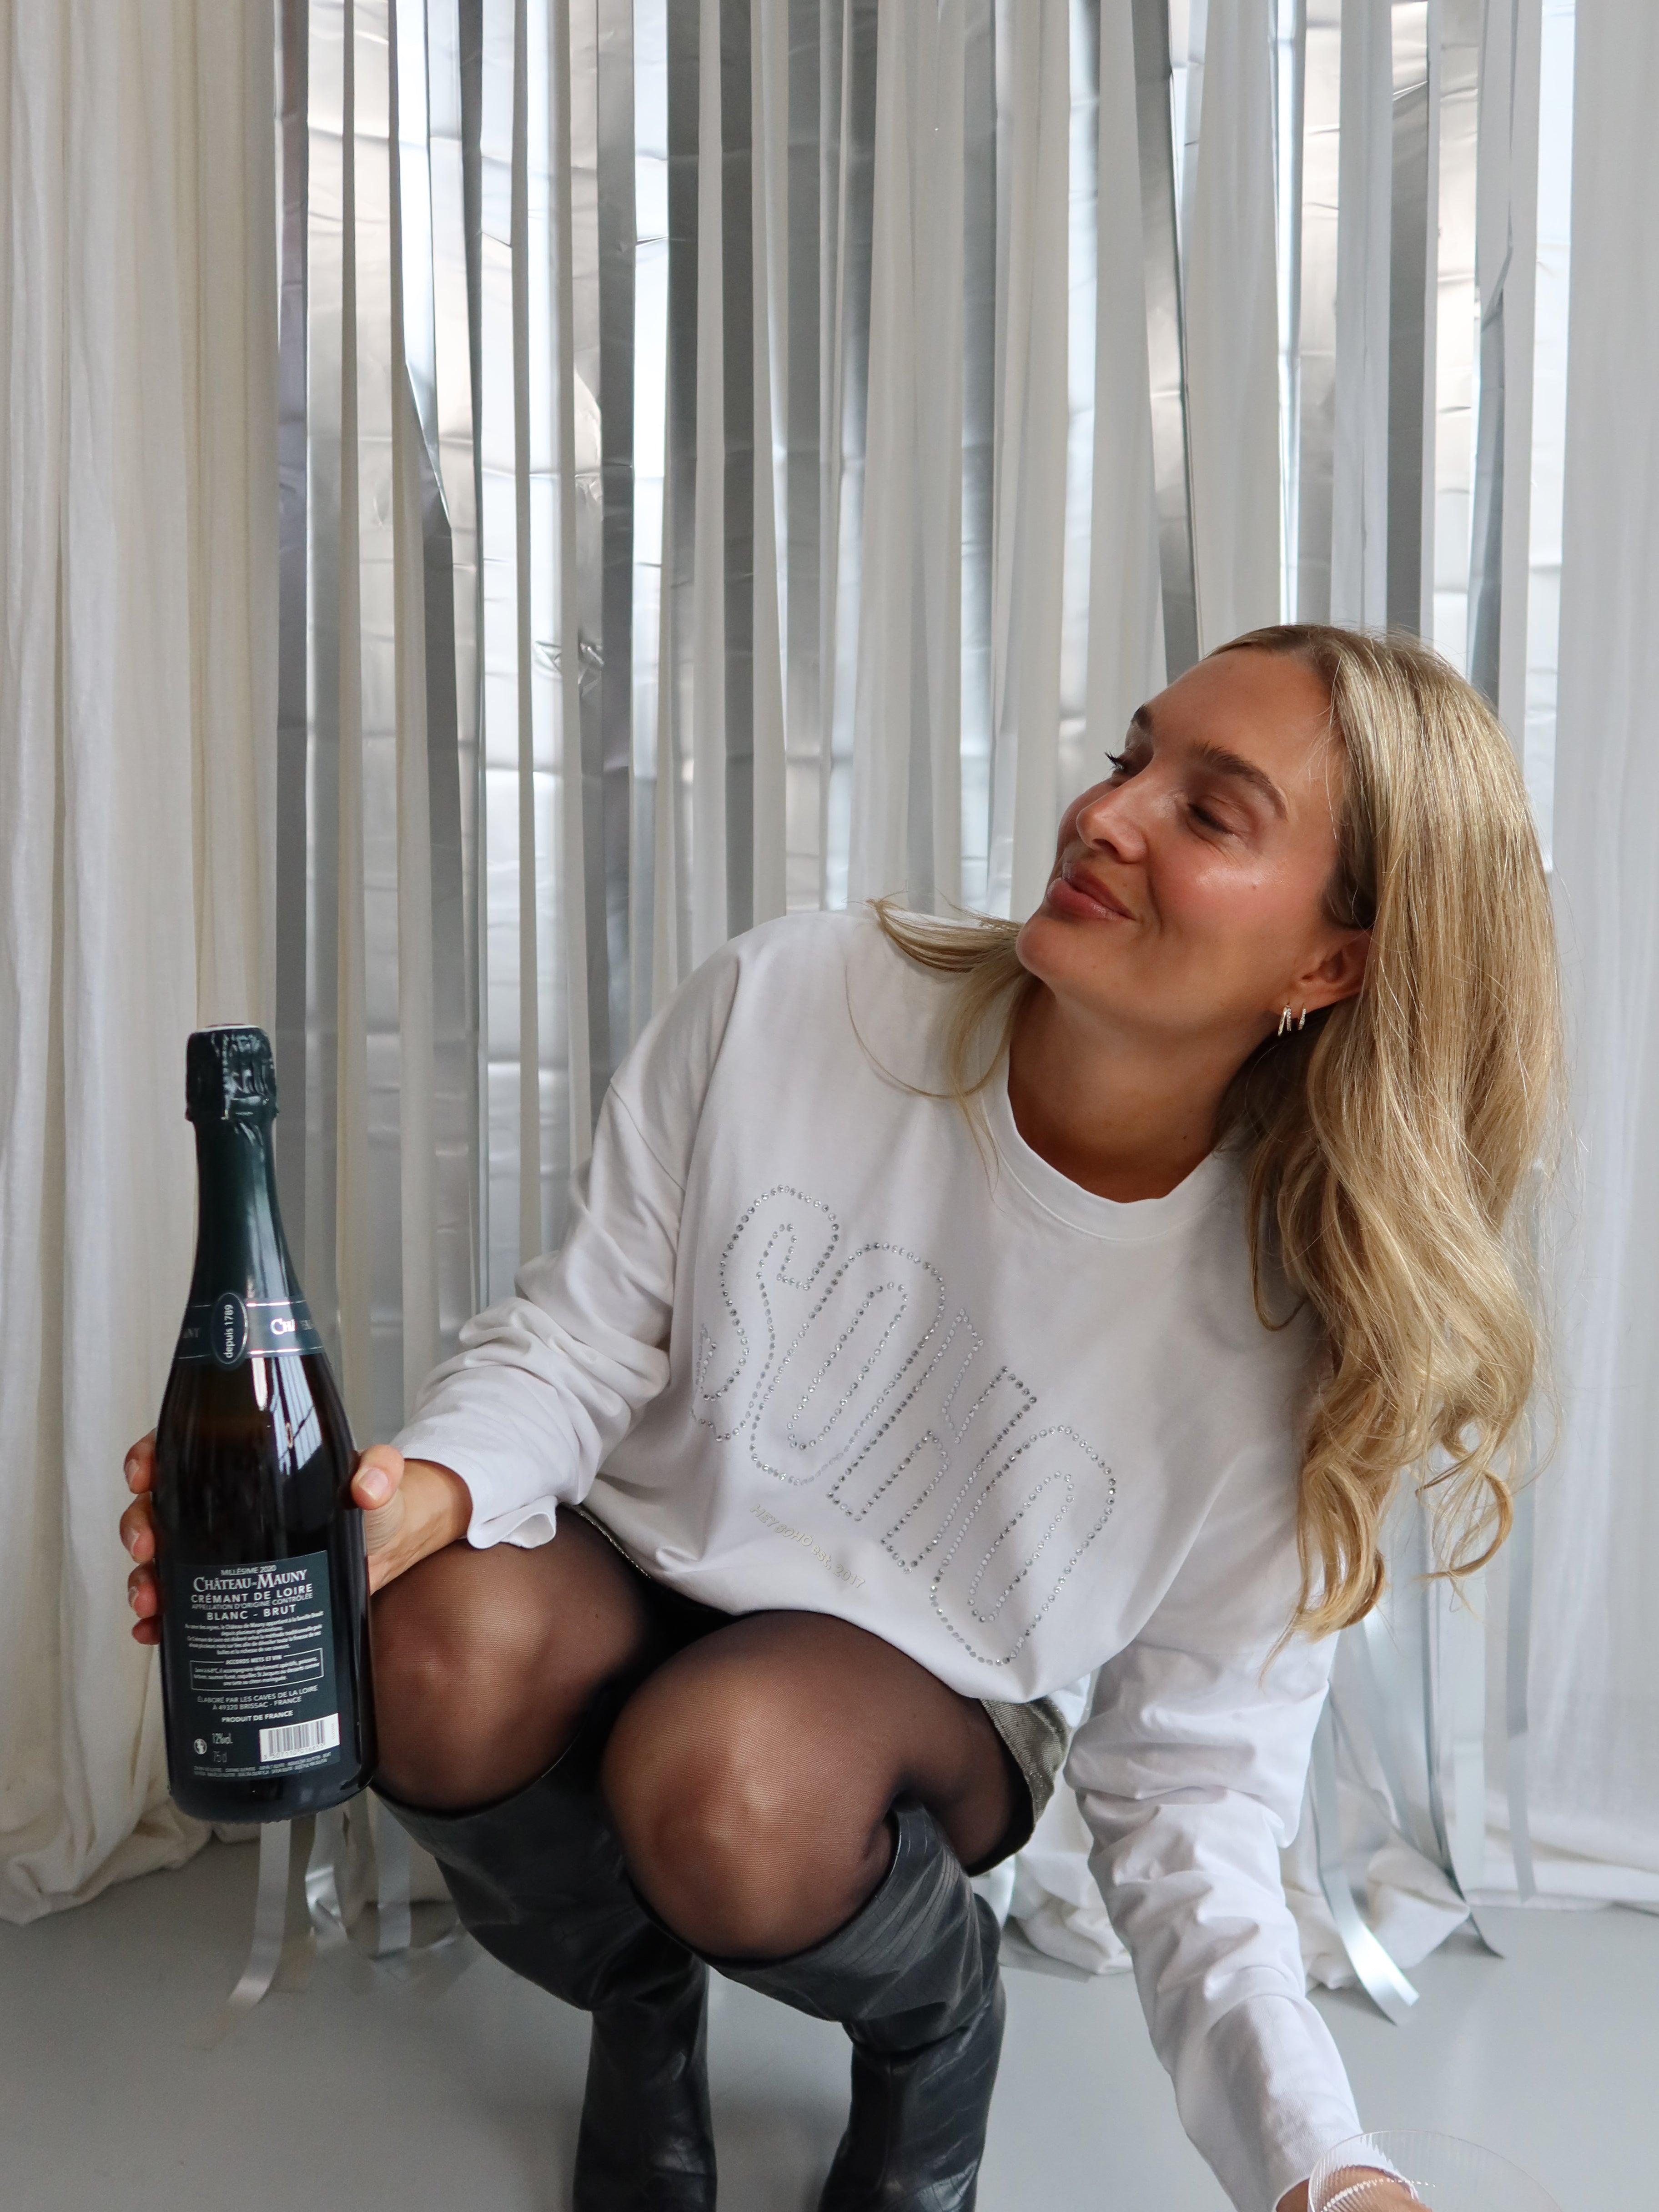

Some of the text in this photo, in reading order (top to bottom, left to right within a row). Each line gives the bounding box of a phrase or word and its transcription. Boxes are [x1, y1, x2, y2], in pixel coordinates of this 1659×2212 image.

[223, 1304, 236, 1358] depuis 1789
[750, 1503, 865, 1588] HEY SOHO est. 2017
[191, 1584, 313, 1604] CRÉMANT DE LOIRE
[234, 1600, 271, 1609] D'ORIGINE
[272, 1592, 313, 1605] CONTRÔLÉE
[207, 1611, 248, 1620] BLANC
[263, 1604, 297, 1617] BRUT
[298, 1685, 318, 1694] LOIRE
[274, 1696, 302, 1706] FRANCE
[265, 1710, 293, 1719] FRANCE
